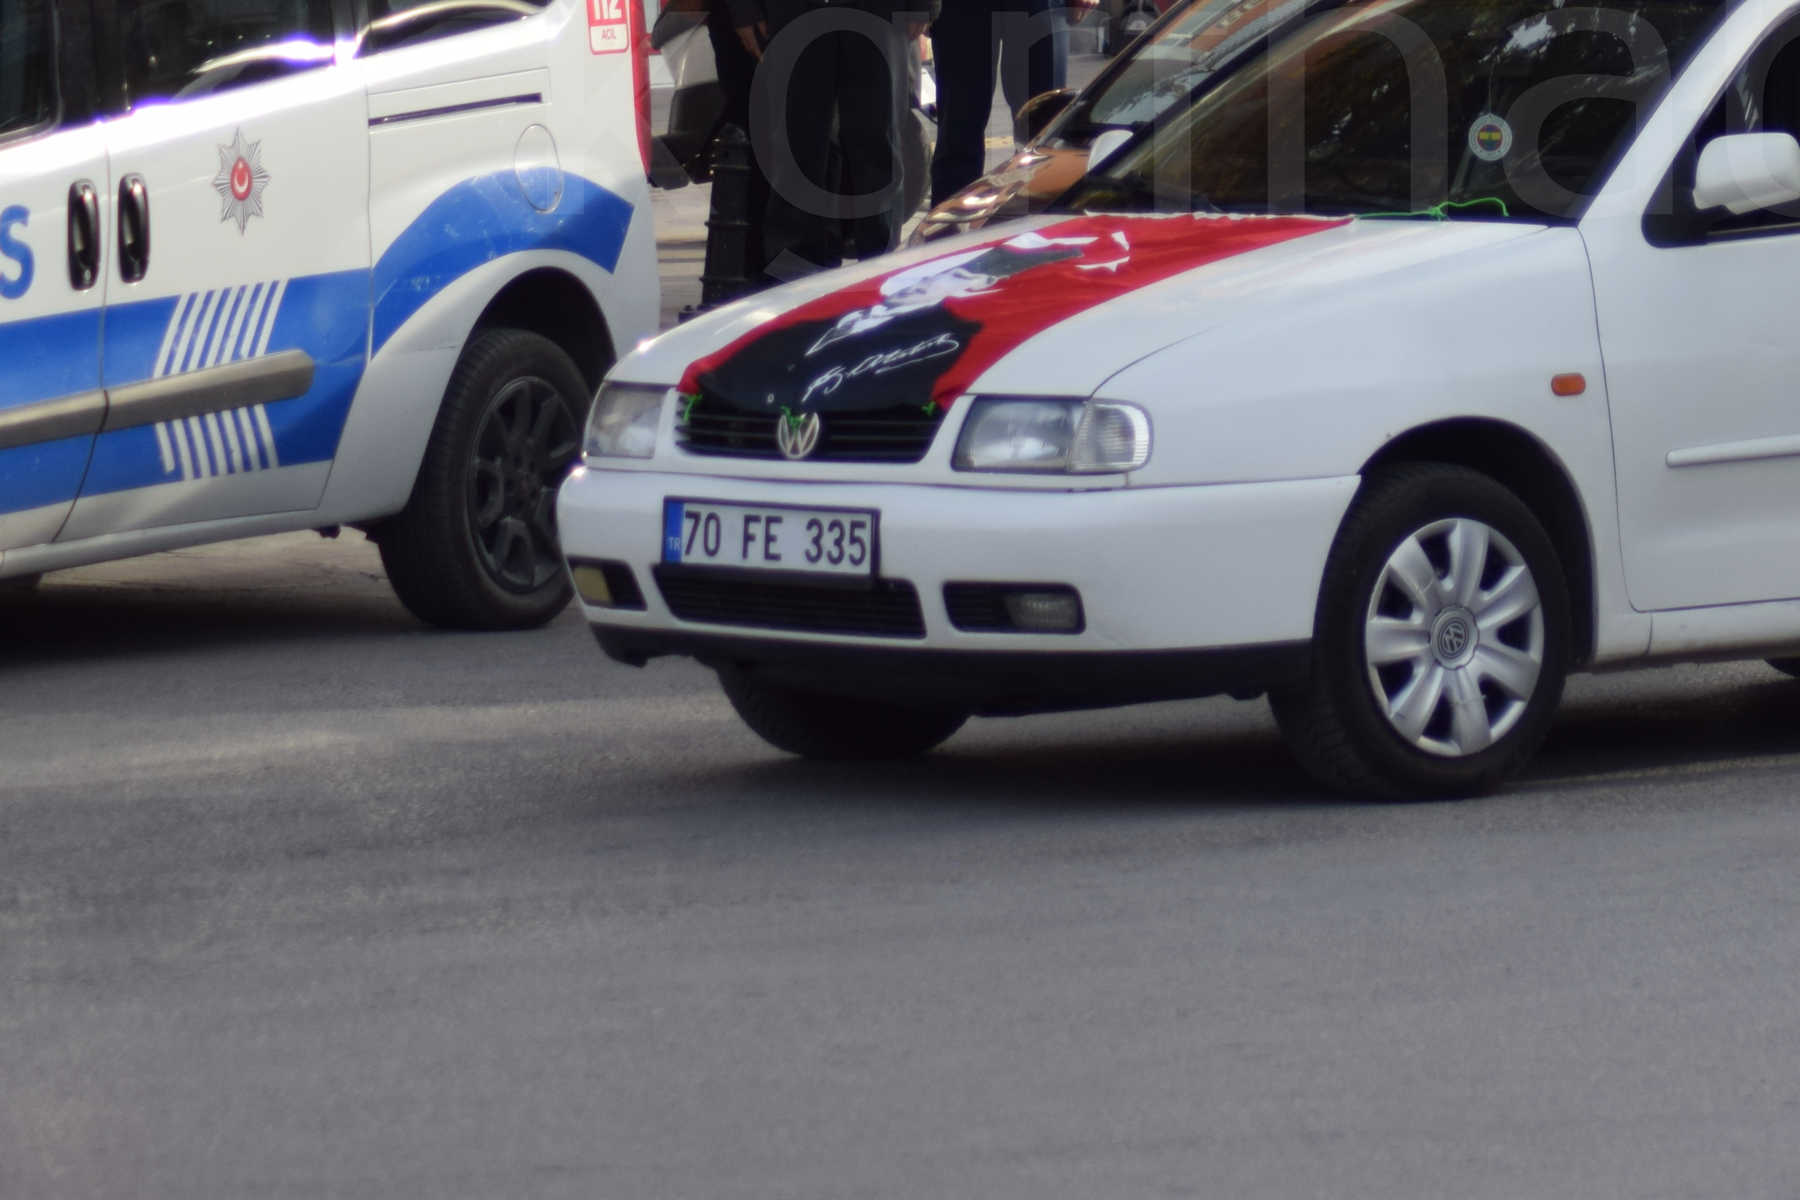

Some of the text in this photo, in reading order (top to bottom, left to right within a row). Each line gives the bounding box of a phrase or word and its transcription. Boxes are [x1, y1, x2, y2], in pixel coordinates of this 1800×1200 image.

[683, 511, 868, 567] 70 FE 335
